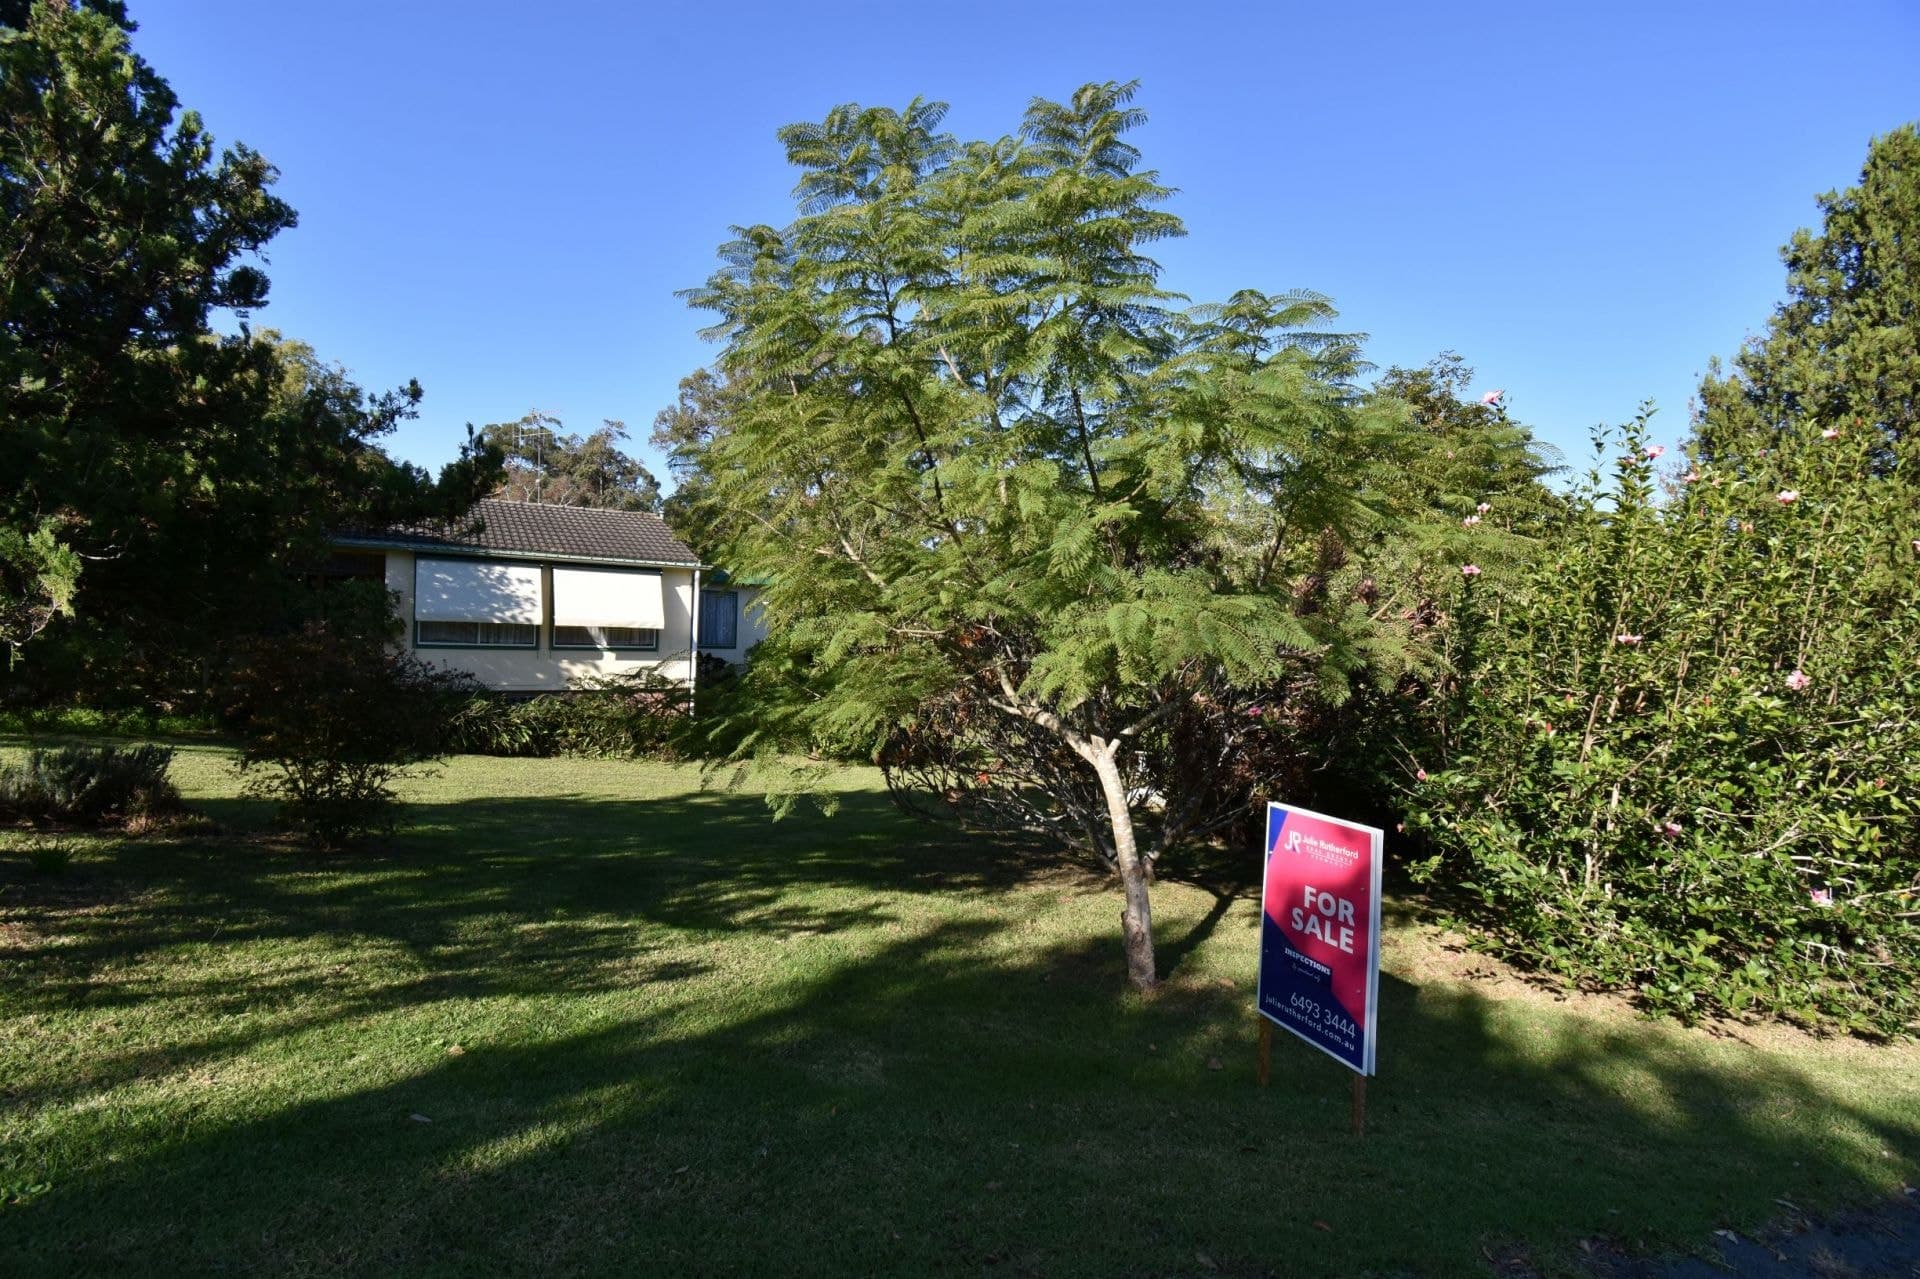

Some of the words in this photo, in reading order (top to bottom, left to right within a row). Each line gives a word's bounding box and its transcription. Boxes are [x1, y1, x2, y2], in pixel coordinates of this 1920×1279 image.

[1284, 831, 1301, 853] JR
[1303, 835, 1319, 848] Julie
[1320, 840, 1359, 860] Rutherford
[1303, 885, 1355, 926] FOR
[1291, 907, 1354, 954] SALE
[1284, 947, 1331, 976] INSPECTIONS
[1290, 992, 1320, 1018] 6493
[1323, 1009, 1356, 1039] 3444
